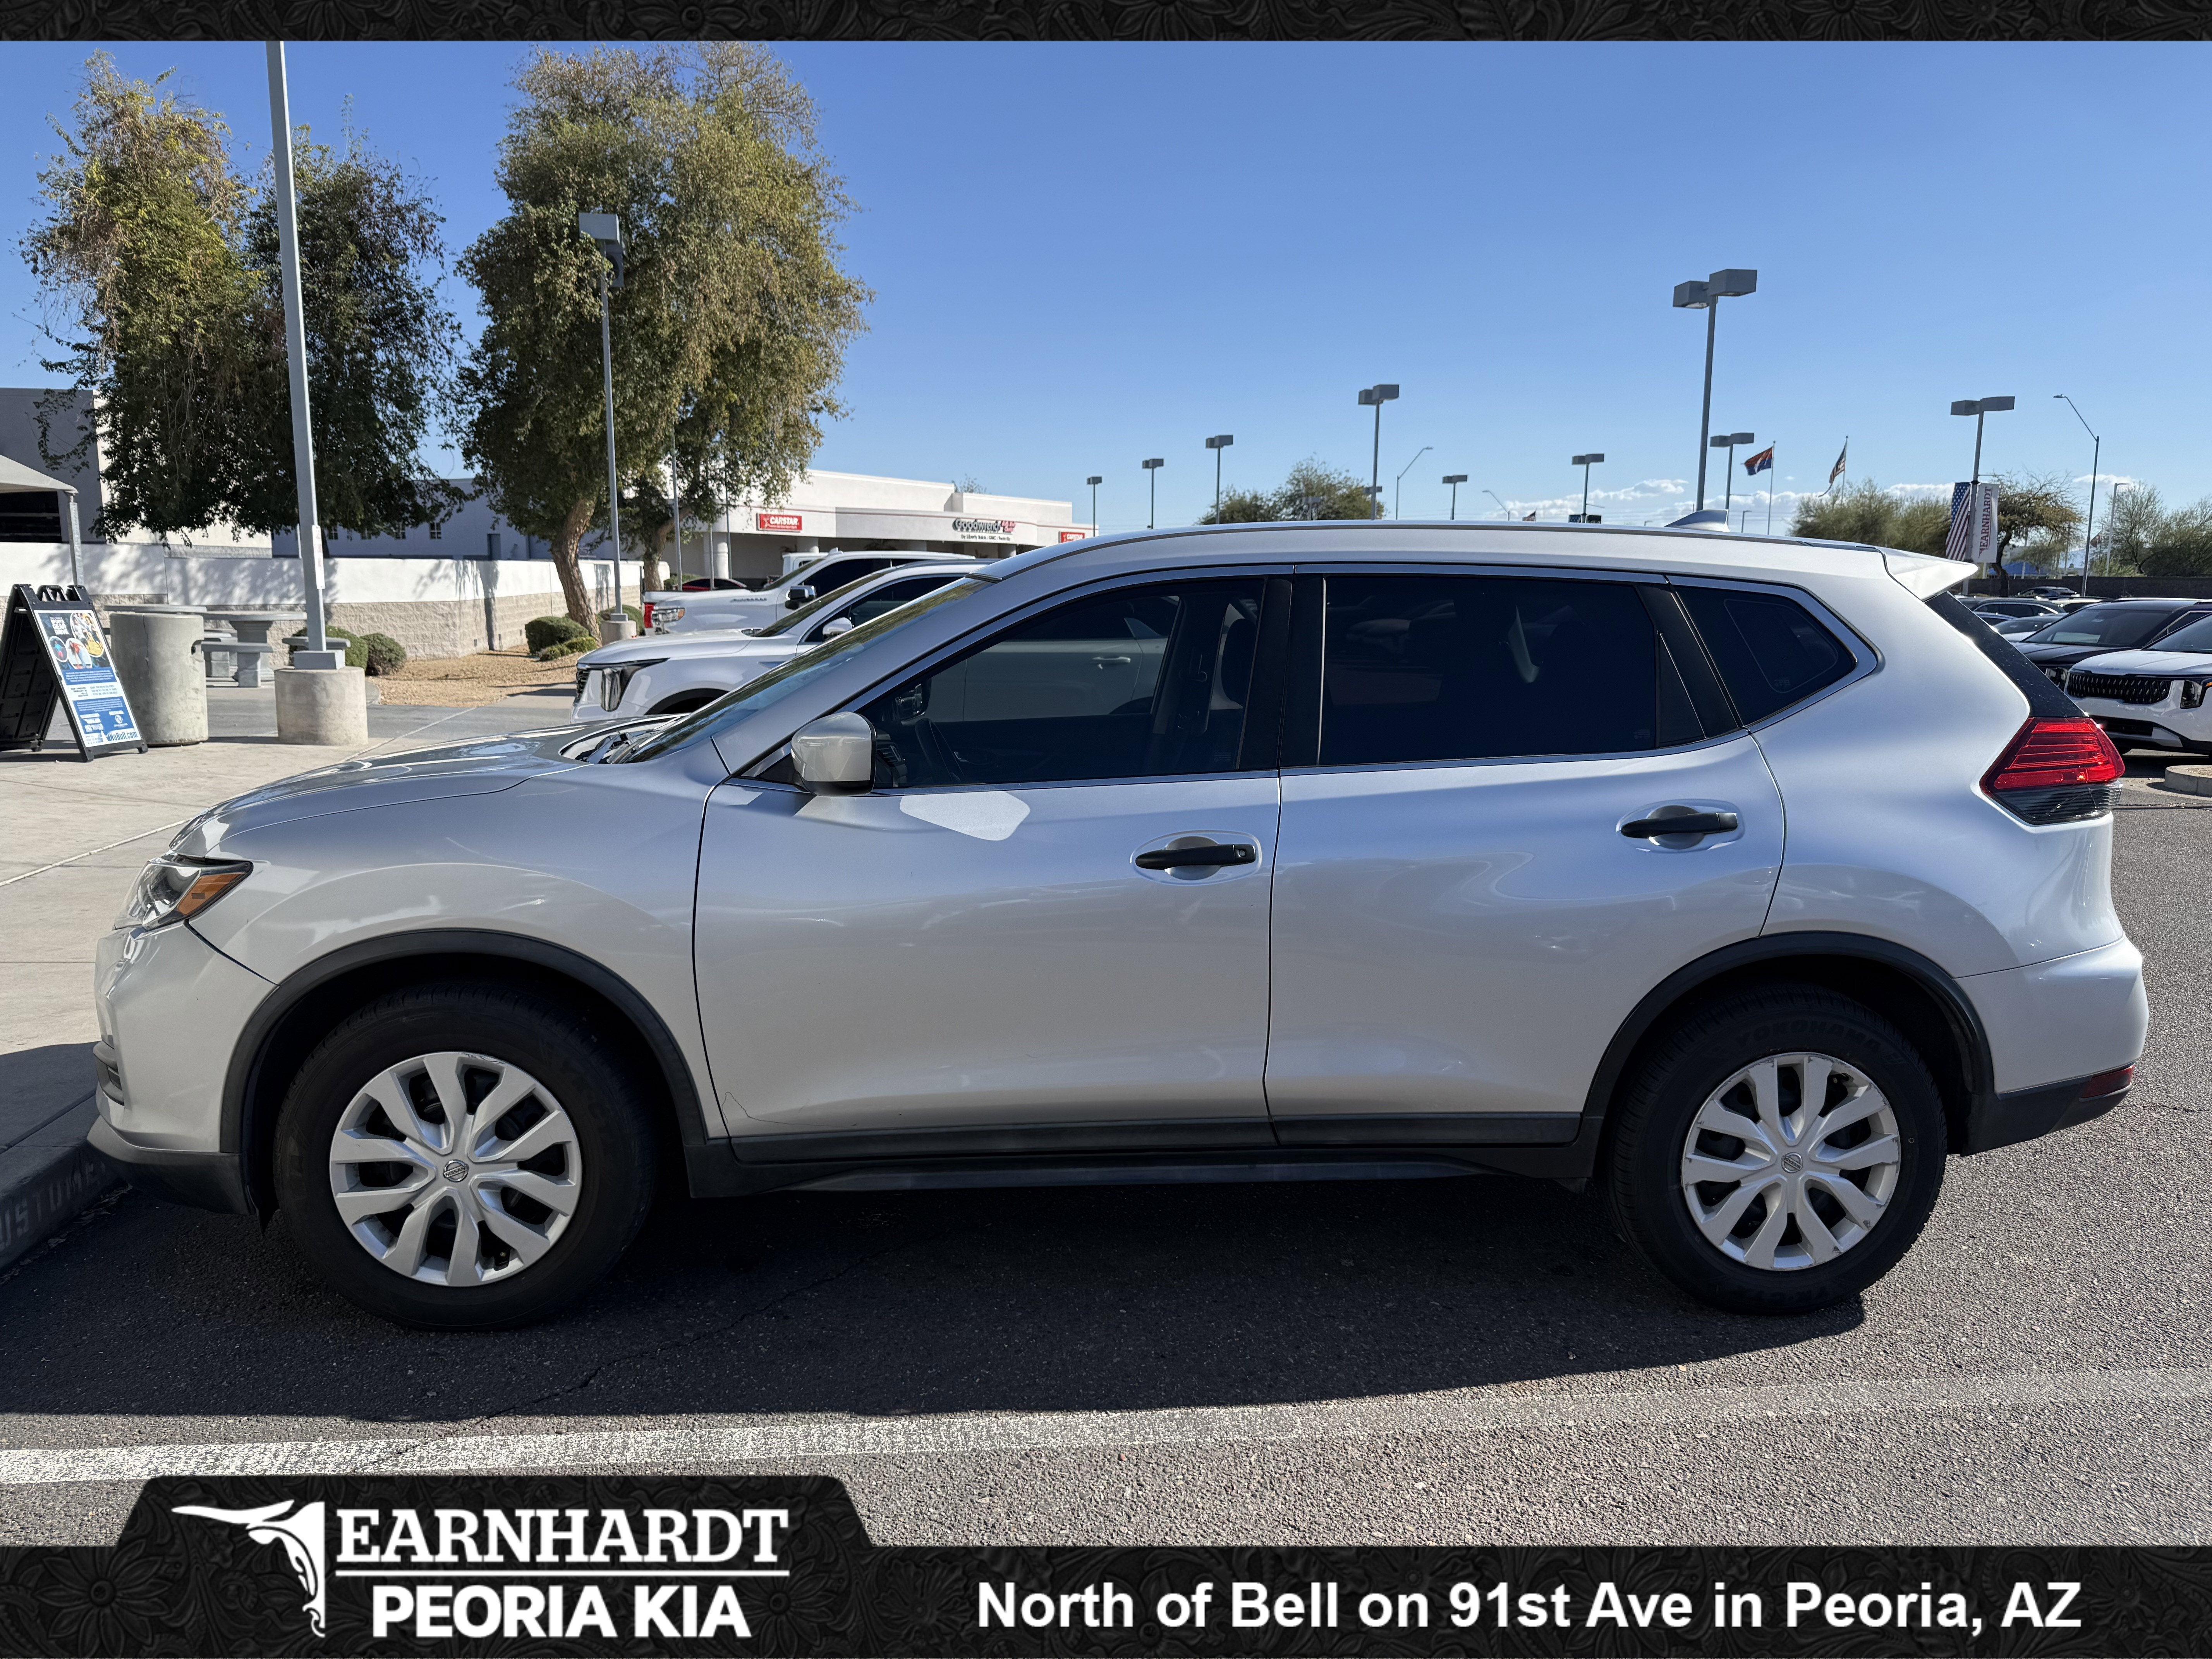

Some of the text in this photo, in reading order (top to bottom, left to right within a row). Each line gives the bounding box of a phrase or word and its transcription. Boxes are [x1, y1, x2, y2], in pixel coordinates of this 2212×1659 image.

[770, 516, 798, 526] CARSTAR
[1980, 486, 1992, 547] EARNHARDT
[953, 518, 1001, 531] Goodwrench
[1735, 1018, 1881, 1052] YOKOHAMA
[445, 1166, 465, 1176] NISSAN
